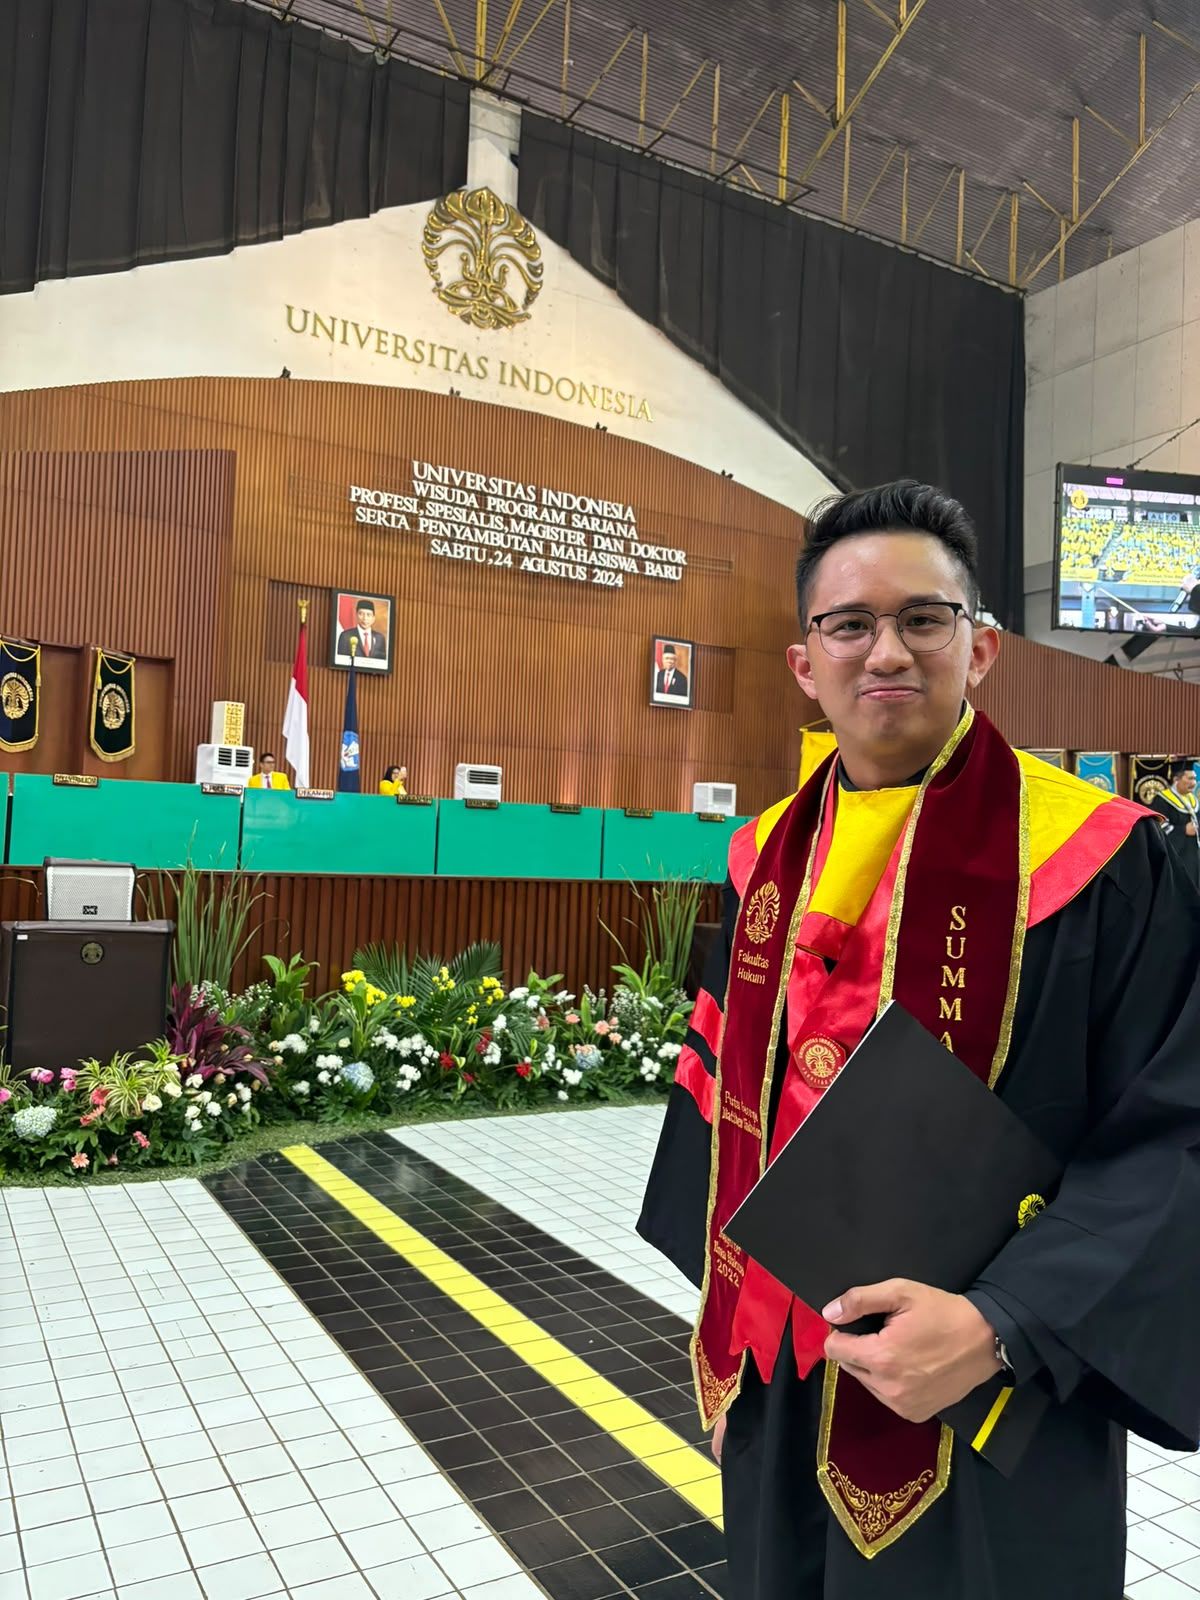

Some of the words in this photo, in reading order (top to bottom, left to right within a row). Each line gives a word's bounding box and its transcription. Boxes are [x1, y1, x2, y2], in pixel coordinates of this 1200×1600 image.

[285, 304, 489, 379] UNIVERSITAS
[499, 361, 655, 422] INDONESIA
[412, 460, 536, 502] UNIVERSITAS
[541, 488, 636, 522] INDONESIA
[412, 480, 479, 509] WISUDA
[487, 496, 566, 525] PROGRAM
[572, 513, 638, 540] SARJANA
[355, 507, 410, 530] SERTA
[419, 519, 544, 555] PENYAMBUTAN
[551, 542, 639, 574] MAHASISWA
[645, 562, 683, 581] BARU
[593, 533, 624, 553] DAN
[631, 542, 687, 565] DOKTOR
[520, 556, 587, 581] AGUSTUS
[592, 569, 624, 587] 2024
[737, 949, 770, 969] Fakultas
[737, 968, 766, 985] Hukum
[716, 1258, 740, 1290] 2022
